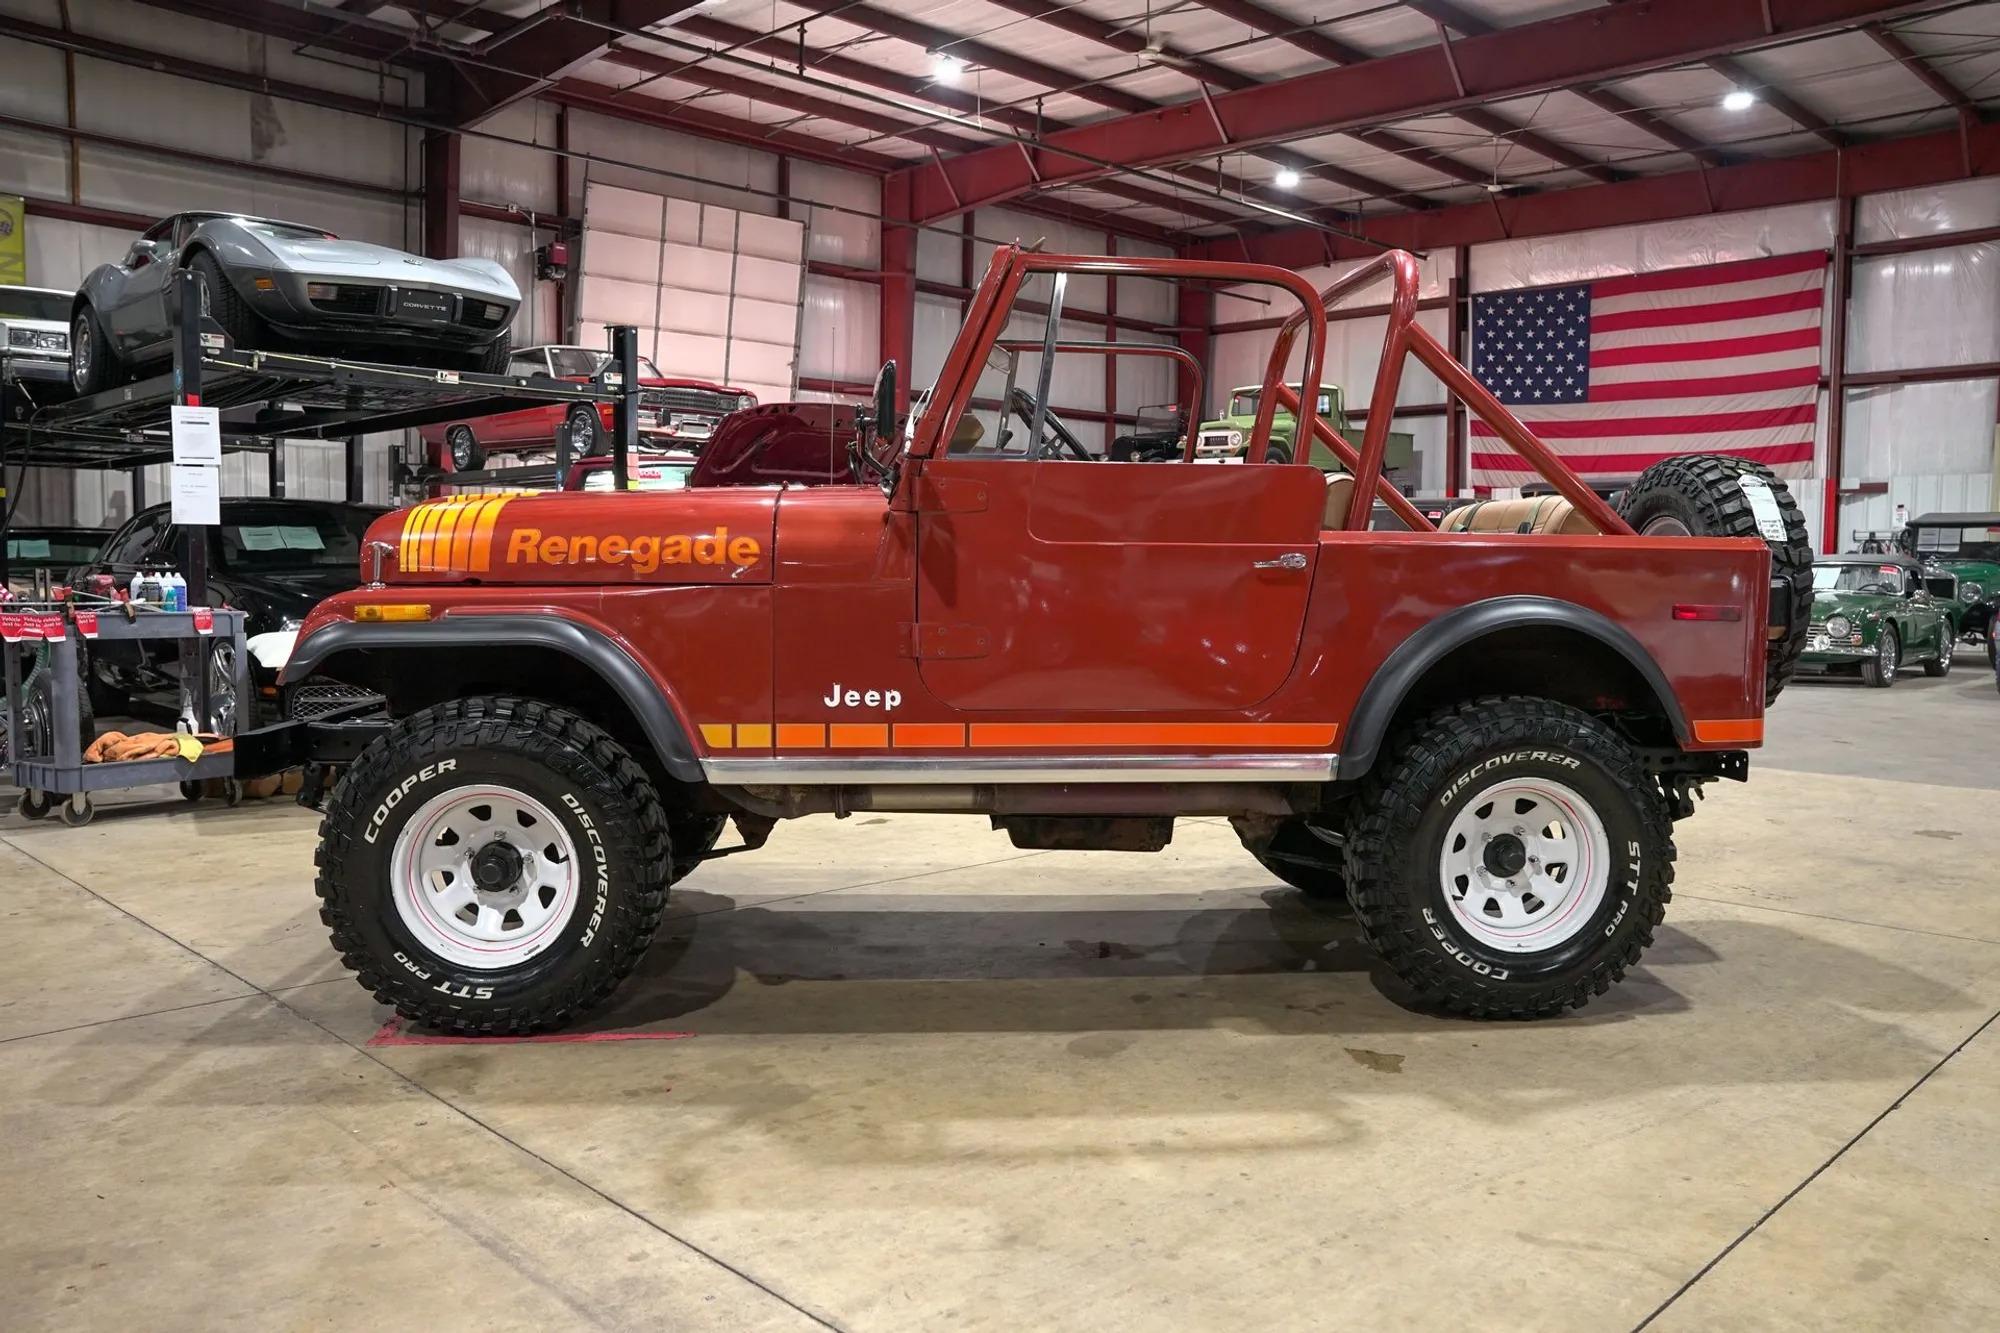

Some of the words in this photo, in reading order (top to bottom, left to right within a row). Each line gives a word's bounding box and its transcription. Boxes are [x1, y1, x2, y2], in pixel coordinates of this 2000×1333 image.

[402, 302, 447, 312] CORVETTE
[506, 526, 761, 574] Renegade
[823, 683, 903, 711] Jeep
[364, 757, 458, 845] COOPER
[1440, 750, 1581, 809] DISCOVERER
[560, 792, 610, 949] DISCOVERER
[1627, 841, 1642, 896] STT
[1604, 900, 1628, 938] PRO
[393, 951, 432, 980] PRO
[1421, 906, 1510, 982] COOPER
[433, 982, 495, 1000] STT
